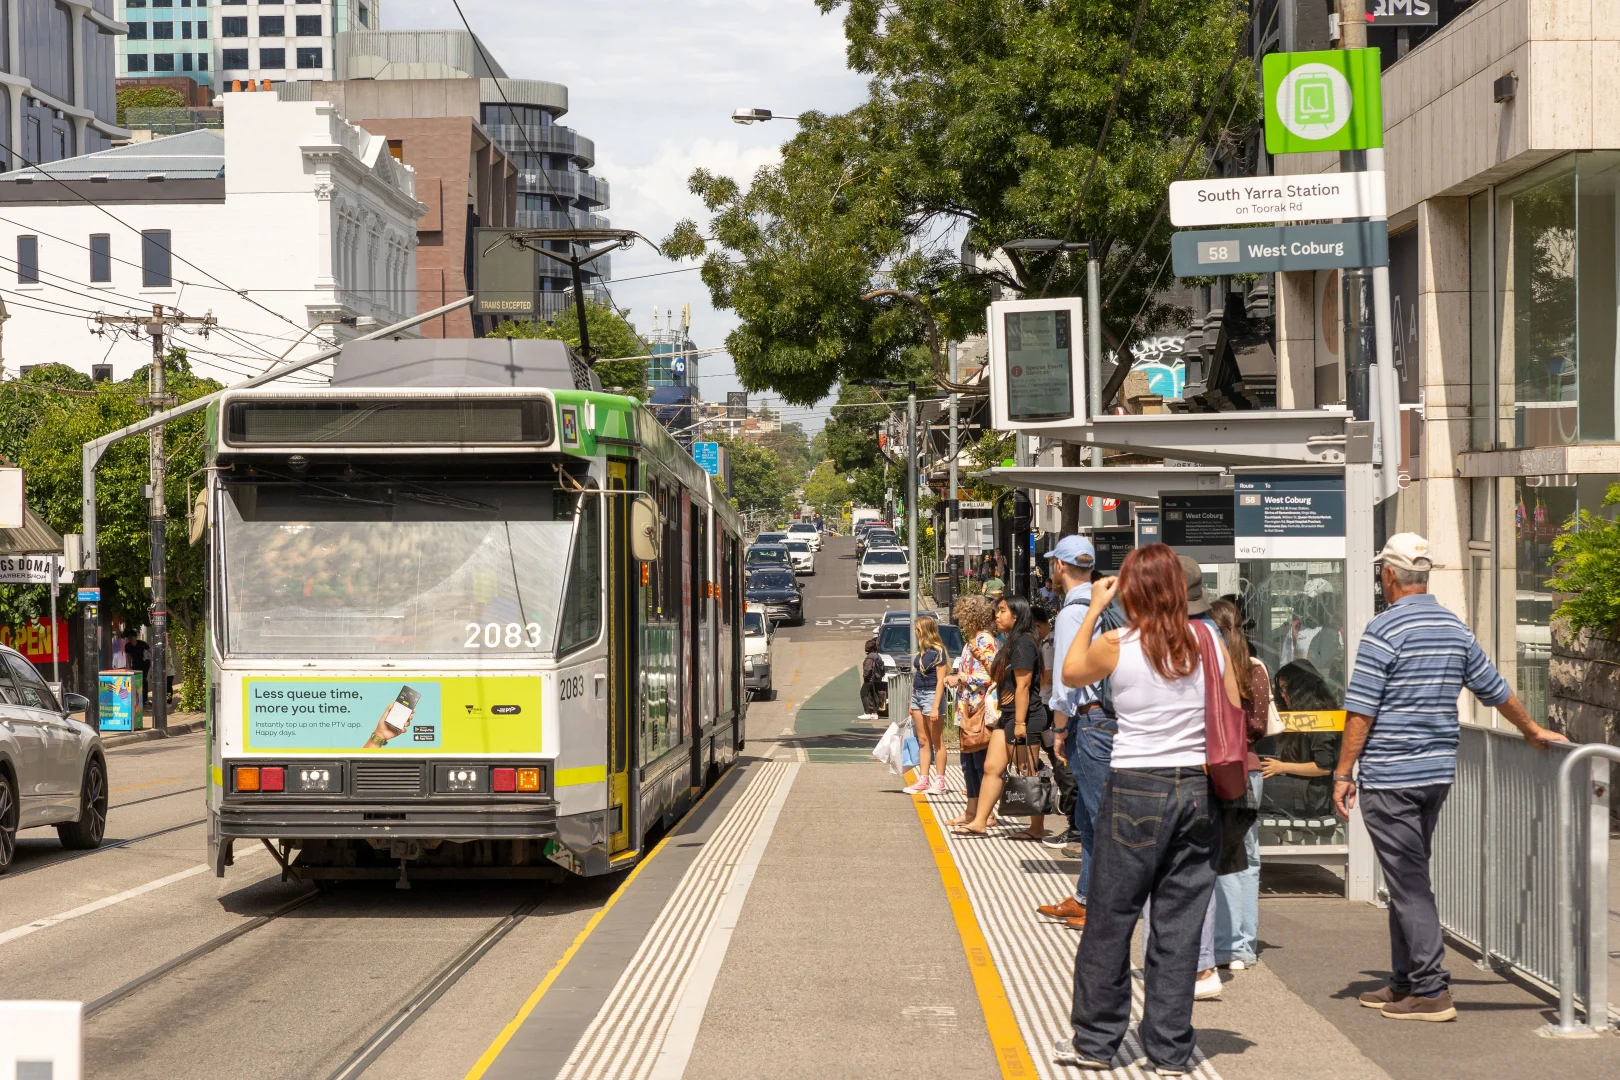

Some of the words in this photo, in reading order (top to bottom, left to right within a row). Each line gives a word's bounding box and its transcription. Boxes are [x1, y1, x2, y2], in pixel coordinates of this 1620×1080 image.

[1197, 188, 1240, 202] South
[1244, 186, 1283, 200] Yarra
[1287, 183, 1340, 198] Station
[1235, 206, 1249, 215] on
[1251, 202, 1287, 214] Toorak
[1289, 202, 1303, 212] Rd
[1208, 246, 1228, 260] 58
[1248, 243, 1286, 258] West
[1290, 241, 1344, 257] Coburg
[480, 301, 500, 310] TRAMS
[501, 301, 532, 310] EXCEPTED
[1245, 496, 1256, 504] 58
[1264, 496, 1284, 504] West
[1284, 496, 1311, 505] Coburg
[1201, 512, 1224, 520] Coburg
[1251, 546, 1266, 554] City
[18, 558, 65, 577] DOMAN
[463, 622, 542, 648] 2083
[560, 675, 584, 701] 2083
[254, 688, 284, 699] Less
[286, 690, 327, 702] queue
[330, 689, 363, 701] time,
[255, 704, 289, 714] more
[291, 704, 315, 716] you
[319, 703, 351, 714] time.
[255, 721, 284, 729] Instantly
[285, 721, 297, 729] top
[347, 722, 363, 730] app.
